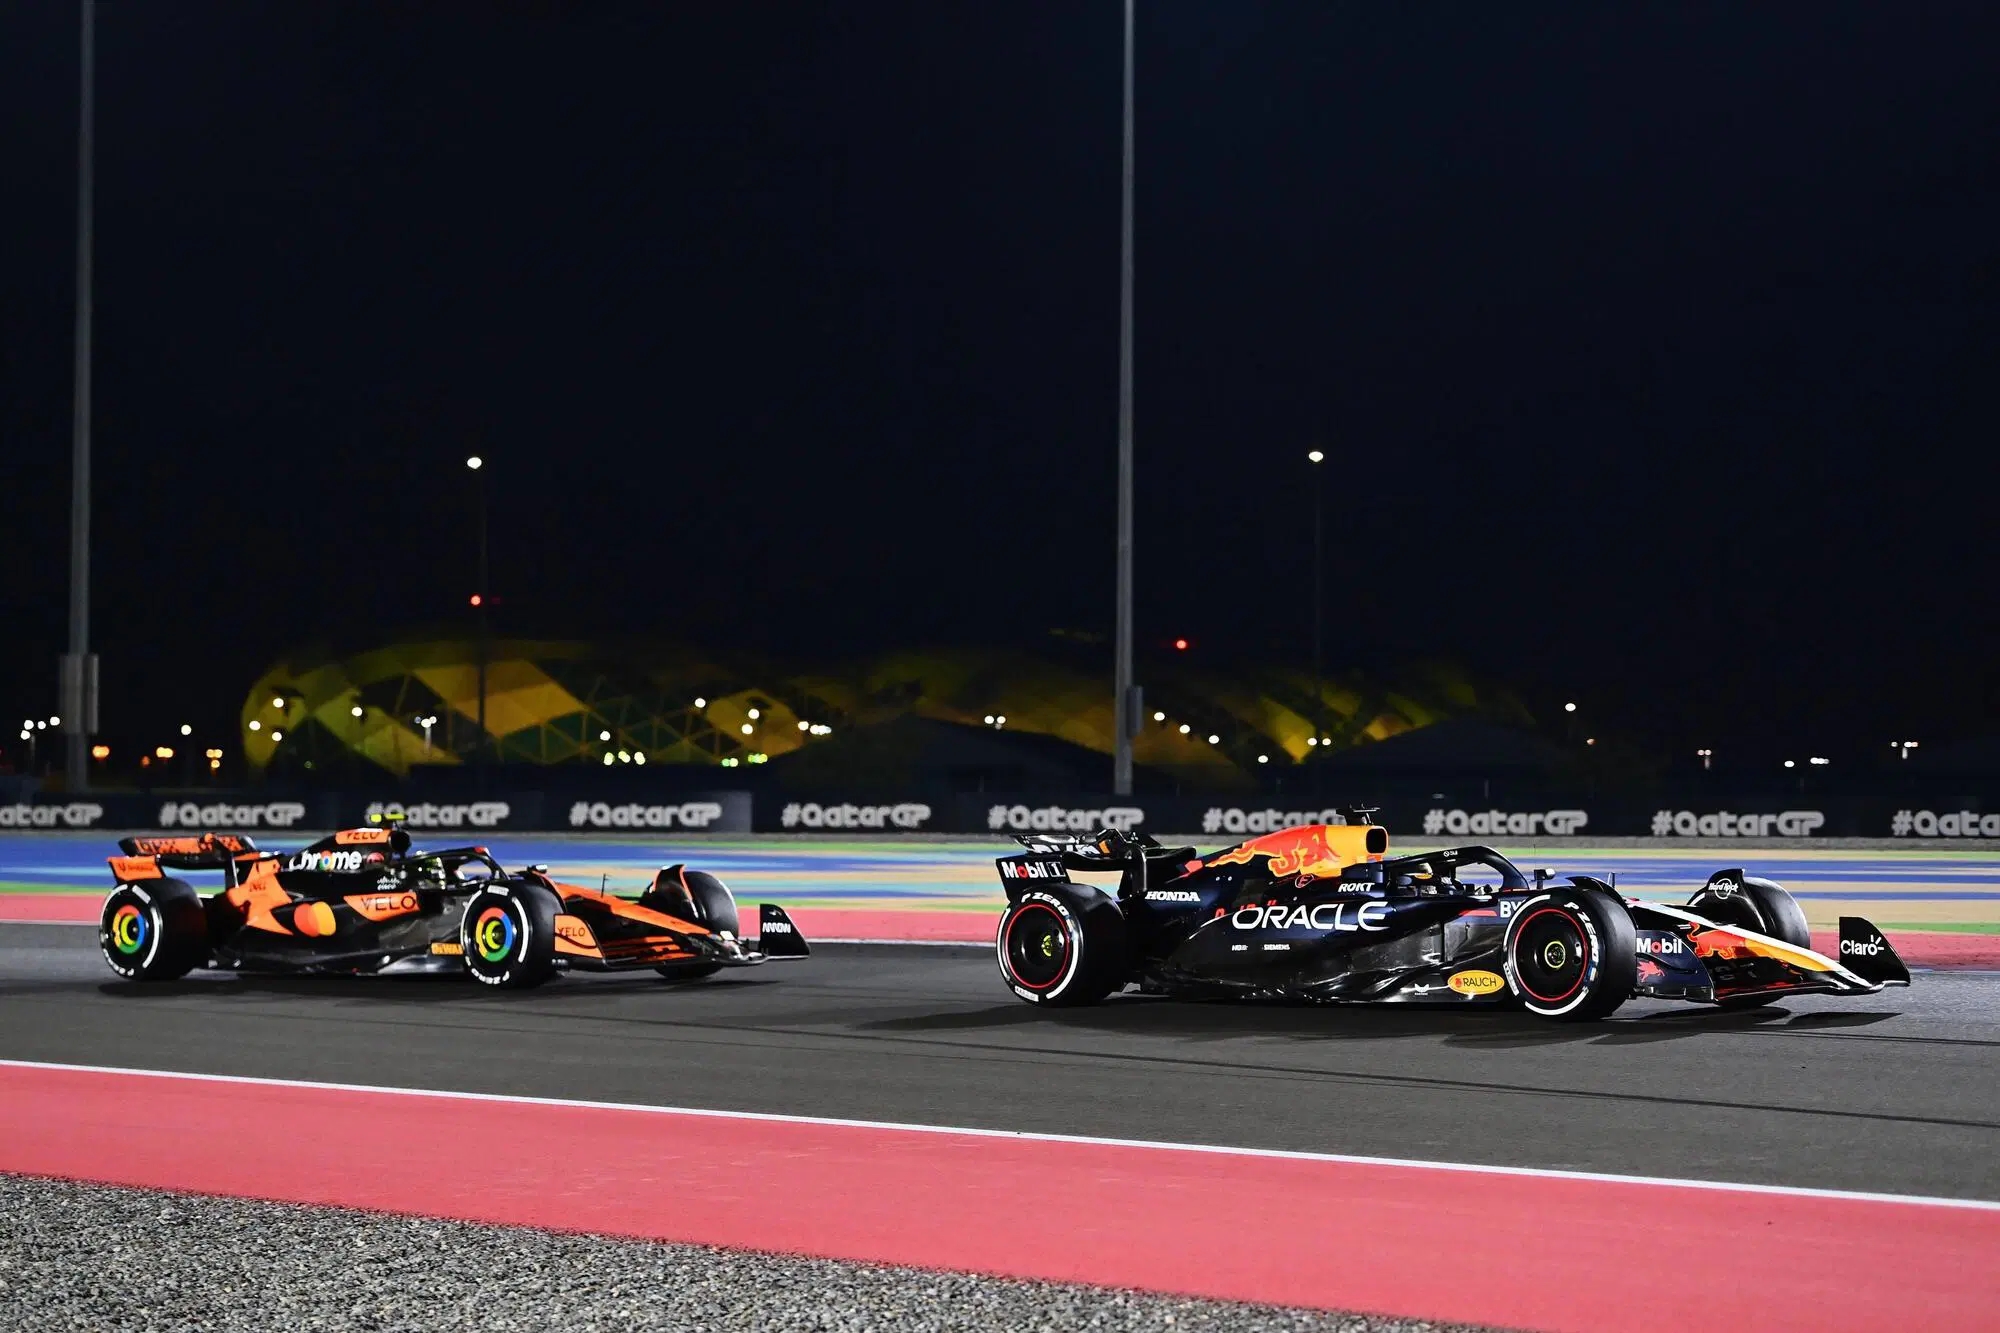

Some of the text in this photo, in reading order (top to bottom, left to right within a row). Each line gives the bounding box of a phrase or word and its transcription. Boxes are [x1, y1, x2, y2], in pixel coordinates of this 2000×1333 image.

[160, 803, 305, 826] #QatarGP
[570, 802, 722, 827] #QatarGP
[782, 803, 931, 828] #QatarGP
[988, 804, 1145, 830] #QatarGP
[1202, 807, 1348, 834] #QatarG
[1424, 809, 1588, 835] #QatarGP
[1652, 810, 1825, 837] #QatarGP
[1001, 861, 1049, 879] Mobil
[1144, 890, 1201, 902] HONDA
[1337, 882, 1376, 893] ROKT
[360, 895, 416, 911] VELO
[1031, 891, 1070, 917] ZERO
[1232, 900, 1391, 932] ORACLE
[557, 926, 586, 937] VELO
[1635, 937, 1683, 954] Mobil
[1840, 936, 1881, 955] Claro
[1463, 976, 1497, 988] RAUCH
